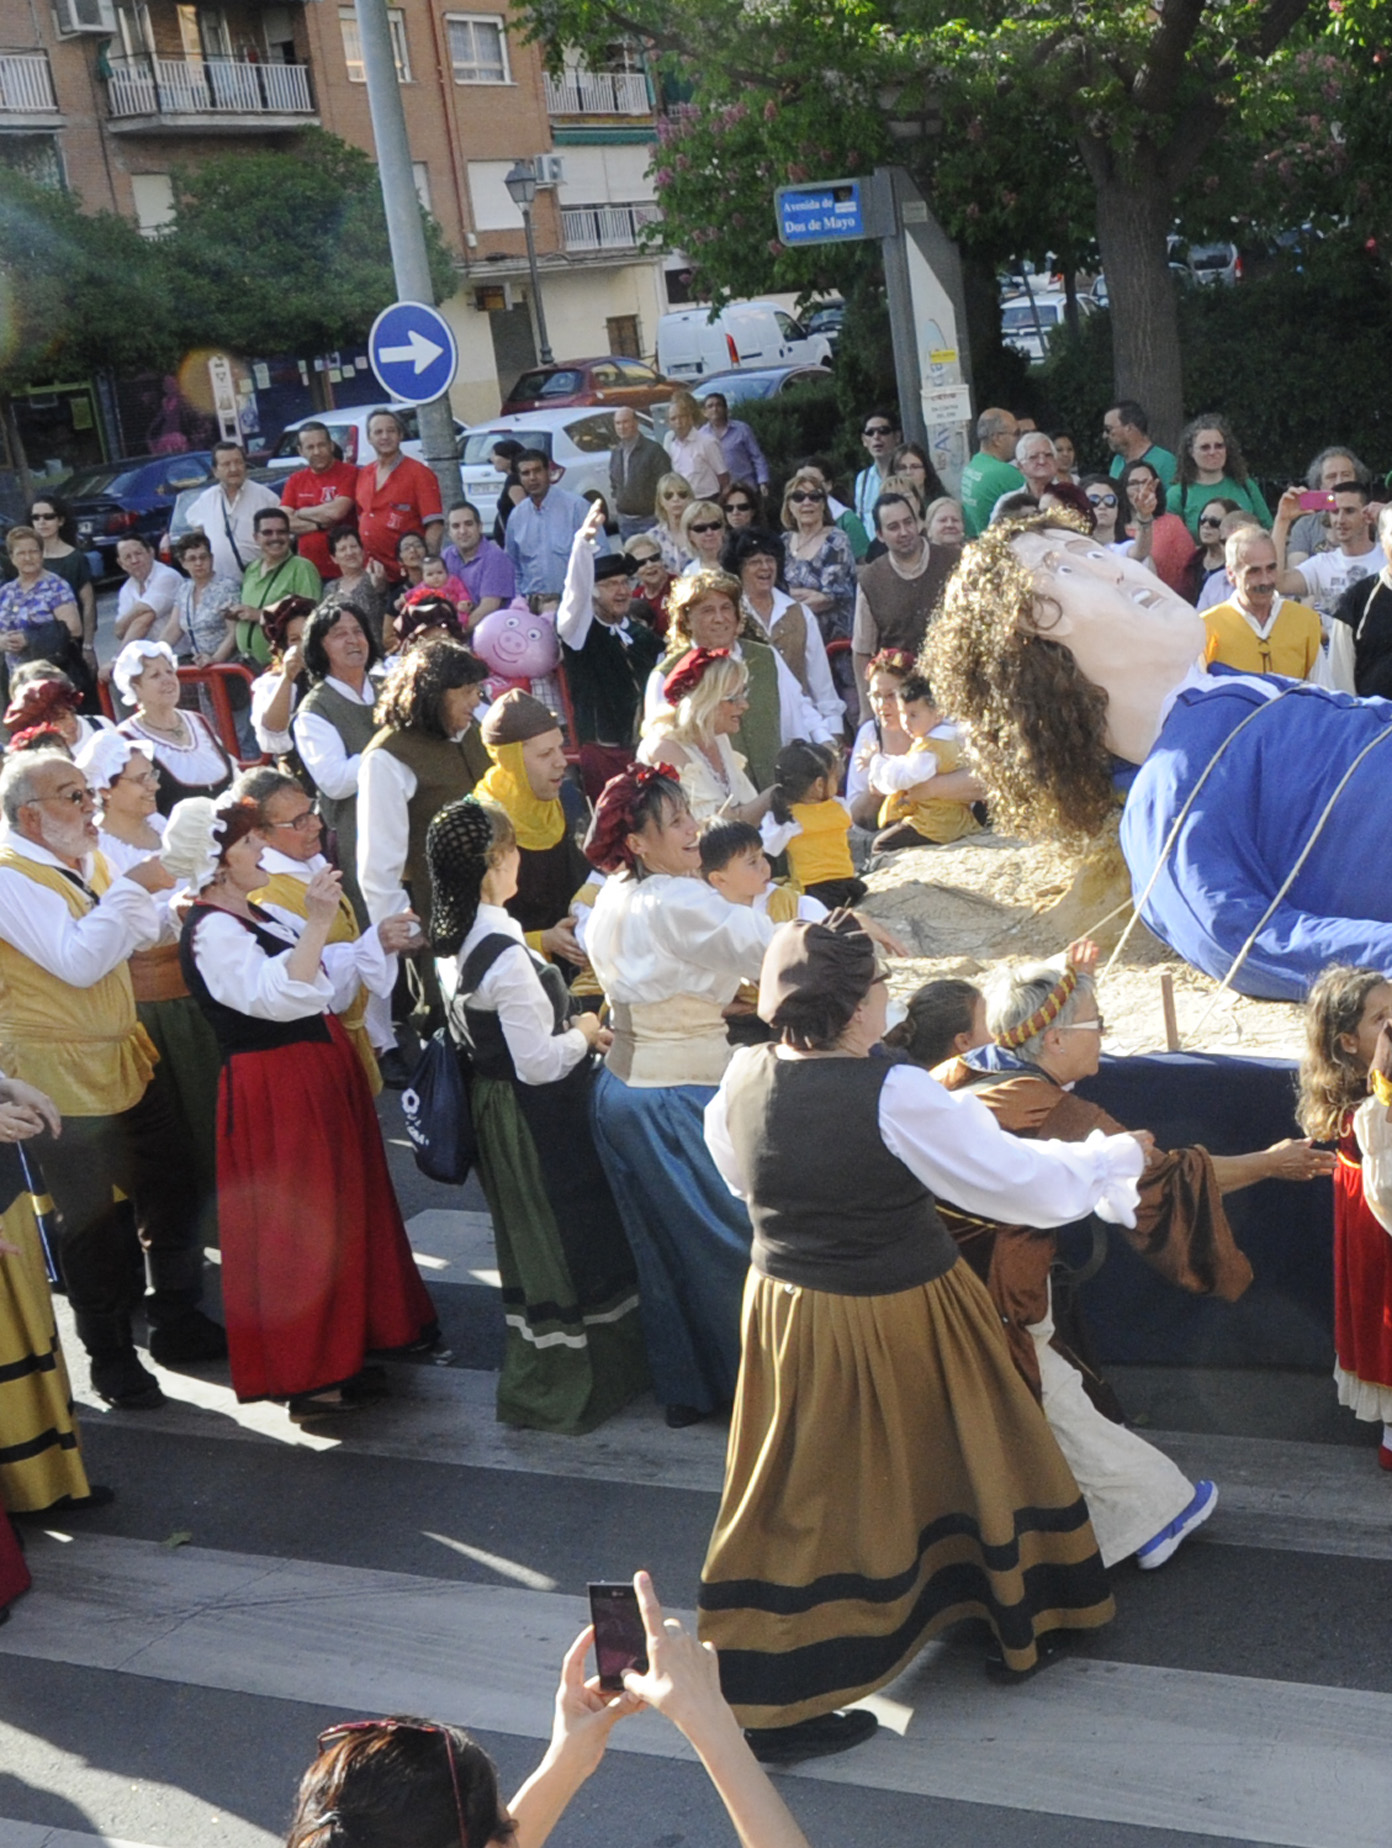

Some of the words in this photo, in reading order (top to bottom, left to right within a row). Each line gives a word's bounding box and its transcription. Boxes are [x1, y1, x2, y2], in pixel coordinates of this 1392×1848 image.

[784, 199, 820, 212] Avenida
[822, 198, 833, 208] de
[785, 221, 806, 233] Dos
[808, 219, 822, 231] de
[823, 216, 856, 230] Mayo
